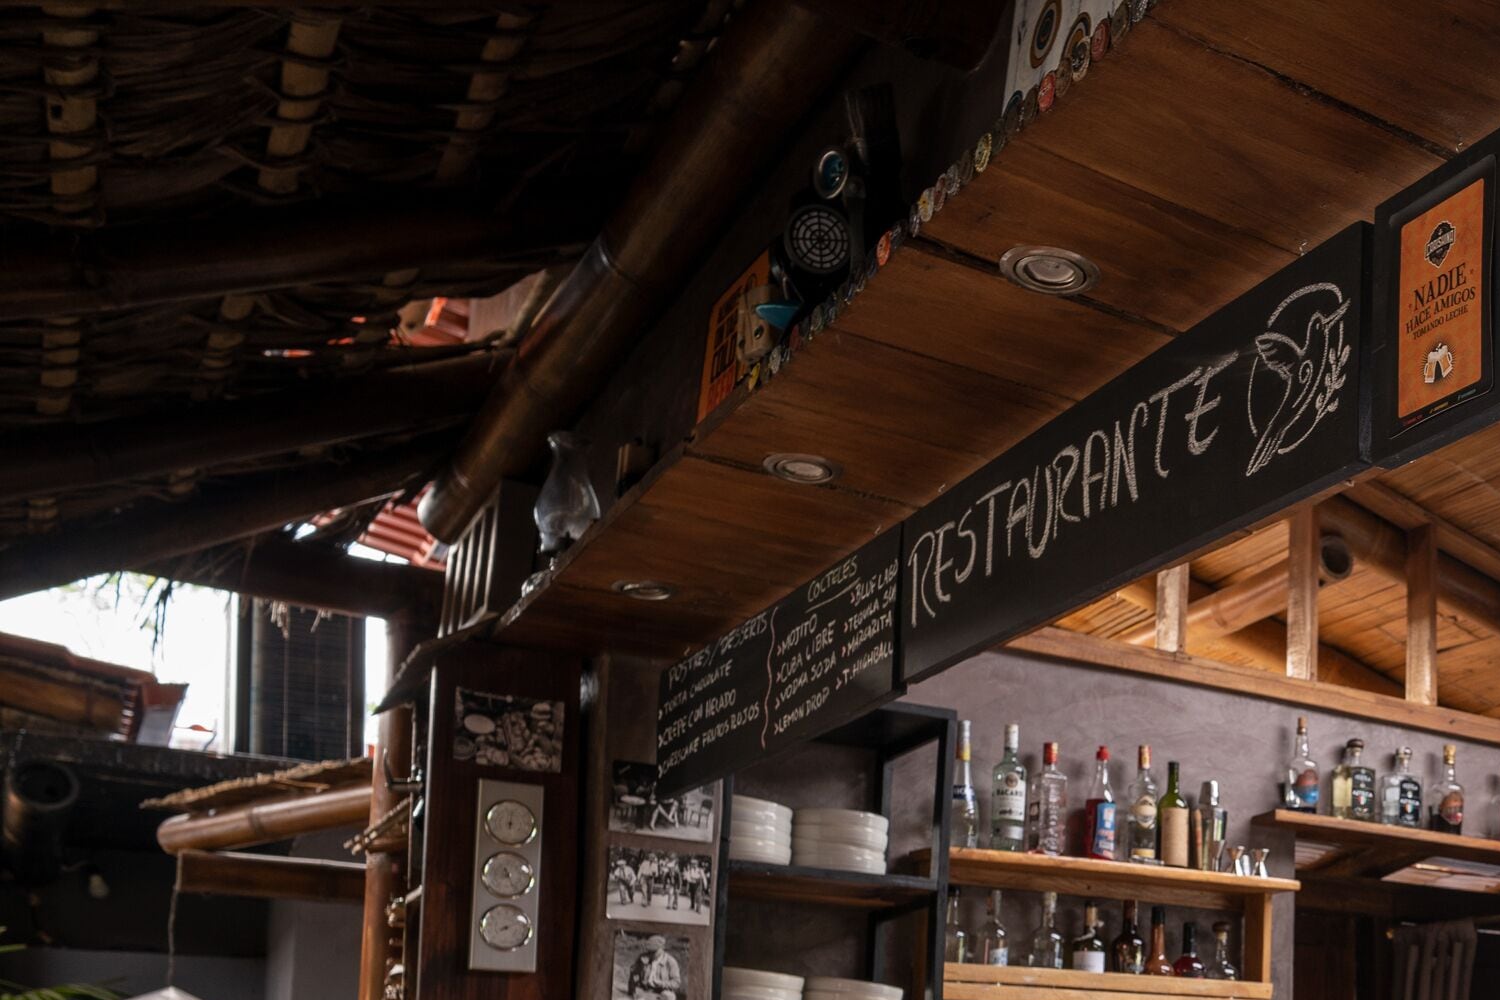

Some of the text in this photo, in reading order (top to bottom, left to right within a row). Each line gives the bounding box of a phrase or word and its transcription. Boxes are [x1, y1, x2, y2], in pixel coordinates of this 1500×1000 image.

[1406, 286, 1476, 334] HACE AMIGOS
[1414, 262, 1467, 312] NADIE
[1412, 304, 1469, 340] TOMANDO LECHE
[906, 352, 1240, 628] RESTAURANTE
[807, 555, 858, 602] COCTELES
[780, 619, 836, 684] CUBA LIBRE
[782, 613, 817, 655] MOJITO
[847, 610, 892, 656] MARGARITA
[780, 651, 837, 703] VODKA SODA
[704, 689, 737, 718] HELADO
[730, 701, 760, 730] ROJOS
[778, 686, 831, 734] LEMON DROP
